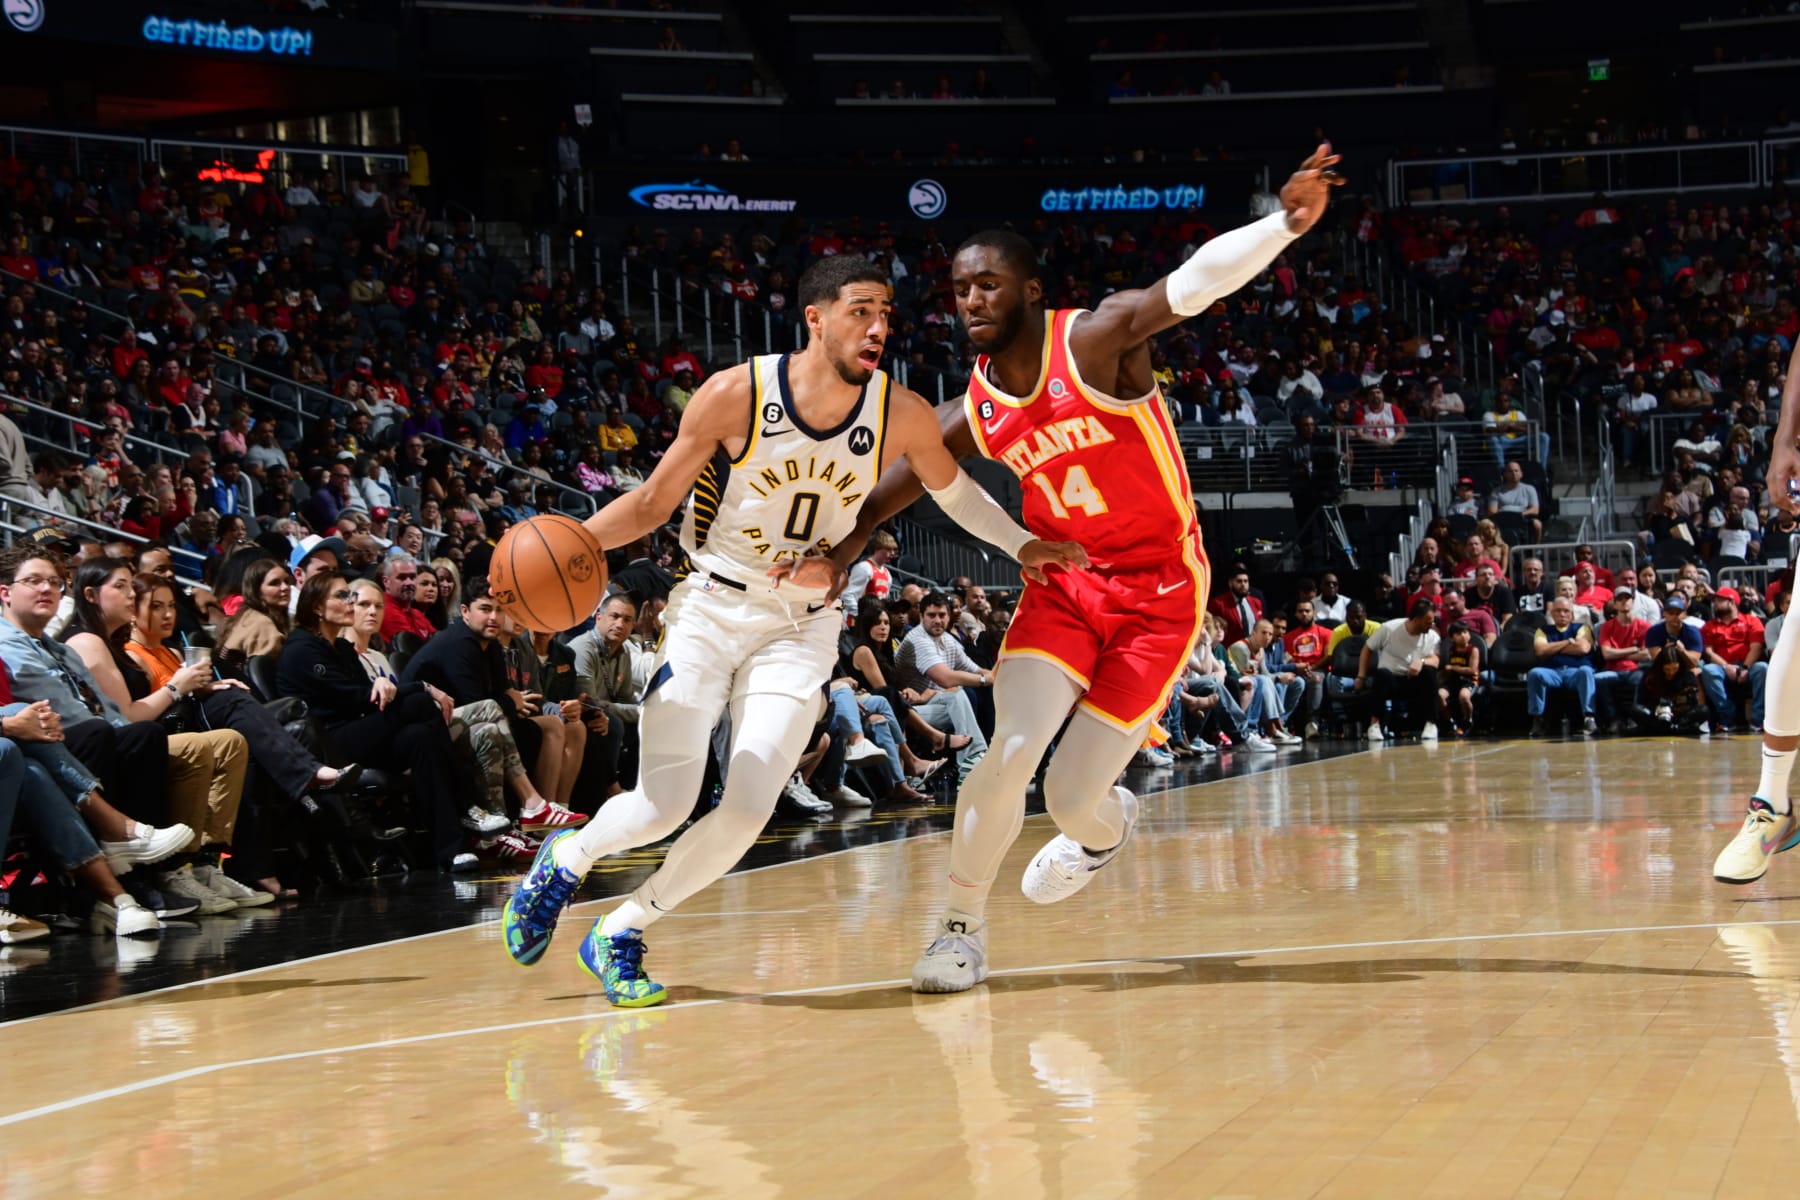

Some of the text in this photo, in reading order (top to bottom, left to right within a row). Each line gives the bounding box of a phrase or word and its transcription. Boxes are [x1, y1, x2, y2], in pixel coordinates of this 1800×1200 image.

[142, 15, 312, 56] GET FIRED UP!
[652, 193, 797, 212] SCANA ENERGY
[1040, 183, 1206, 211] GET FIRED UP!
[767, 404, 780, 421] 6
[981, 402, 992, 418] 6
[749, 457, 862, 507] INDIANA
[1031, 463, 1110, 520] 14
[783, 492, 820, 541] 0
